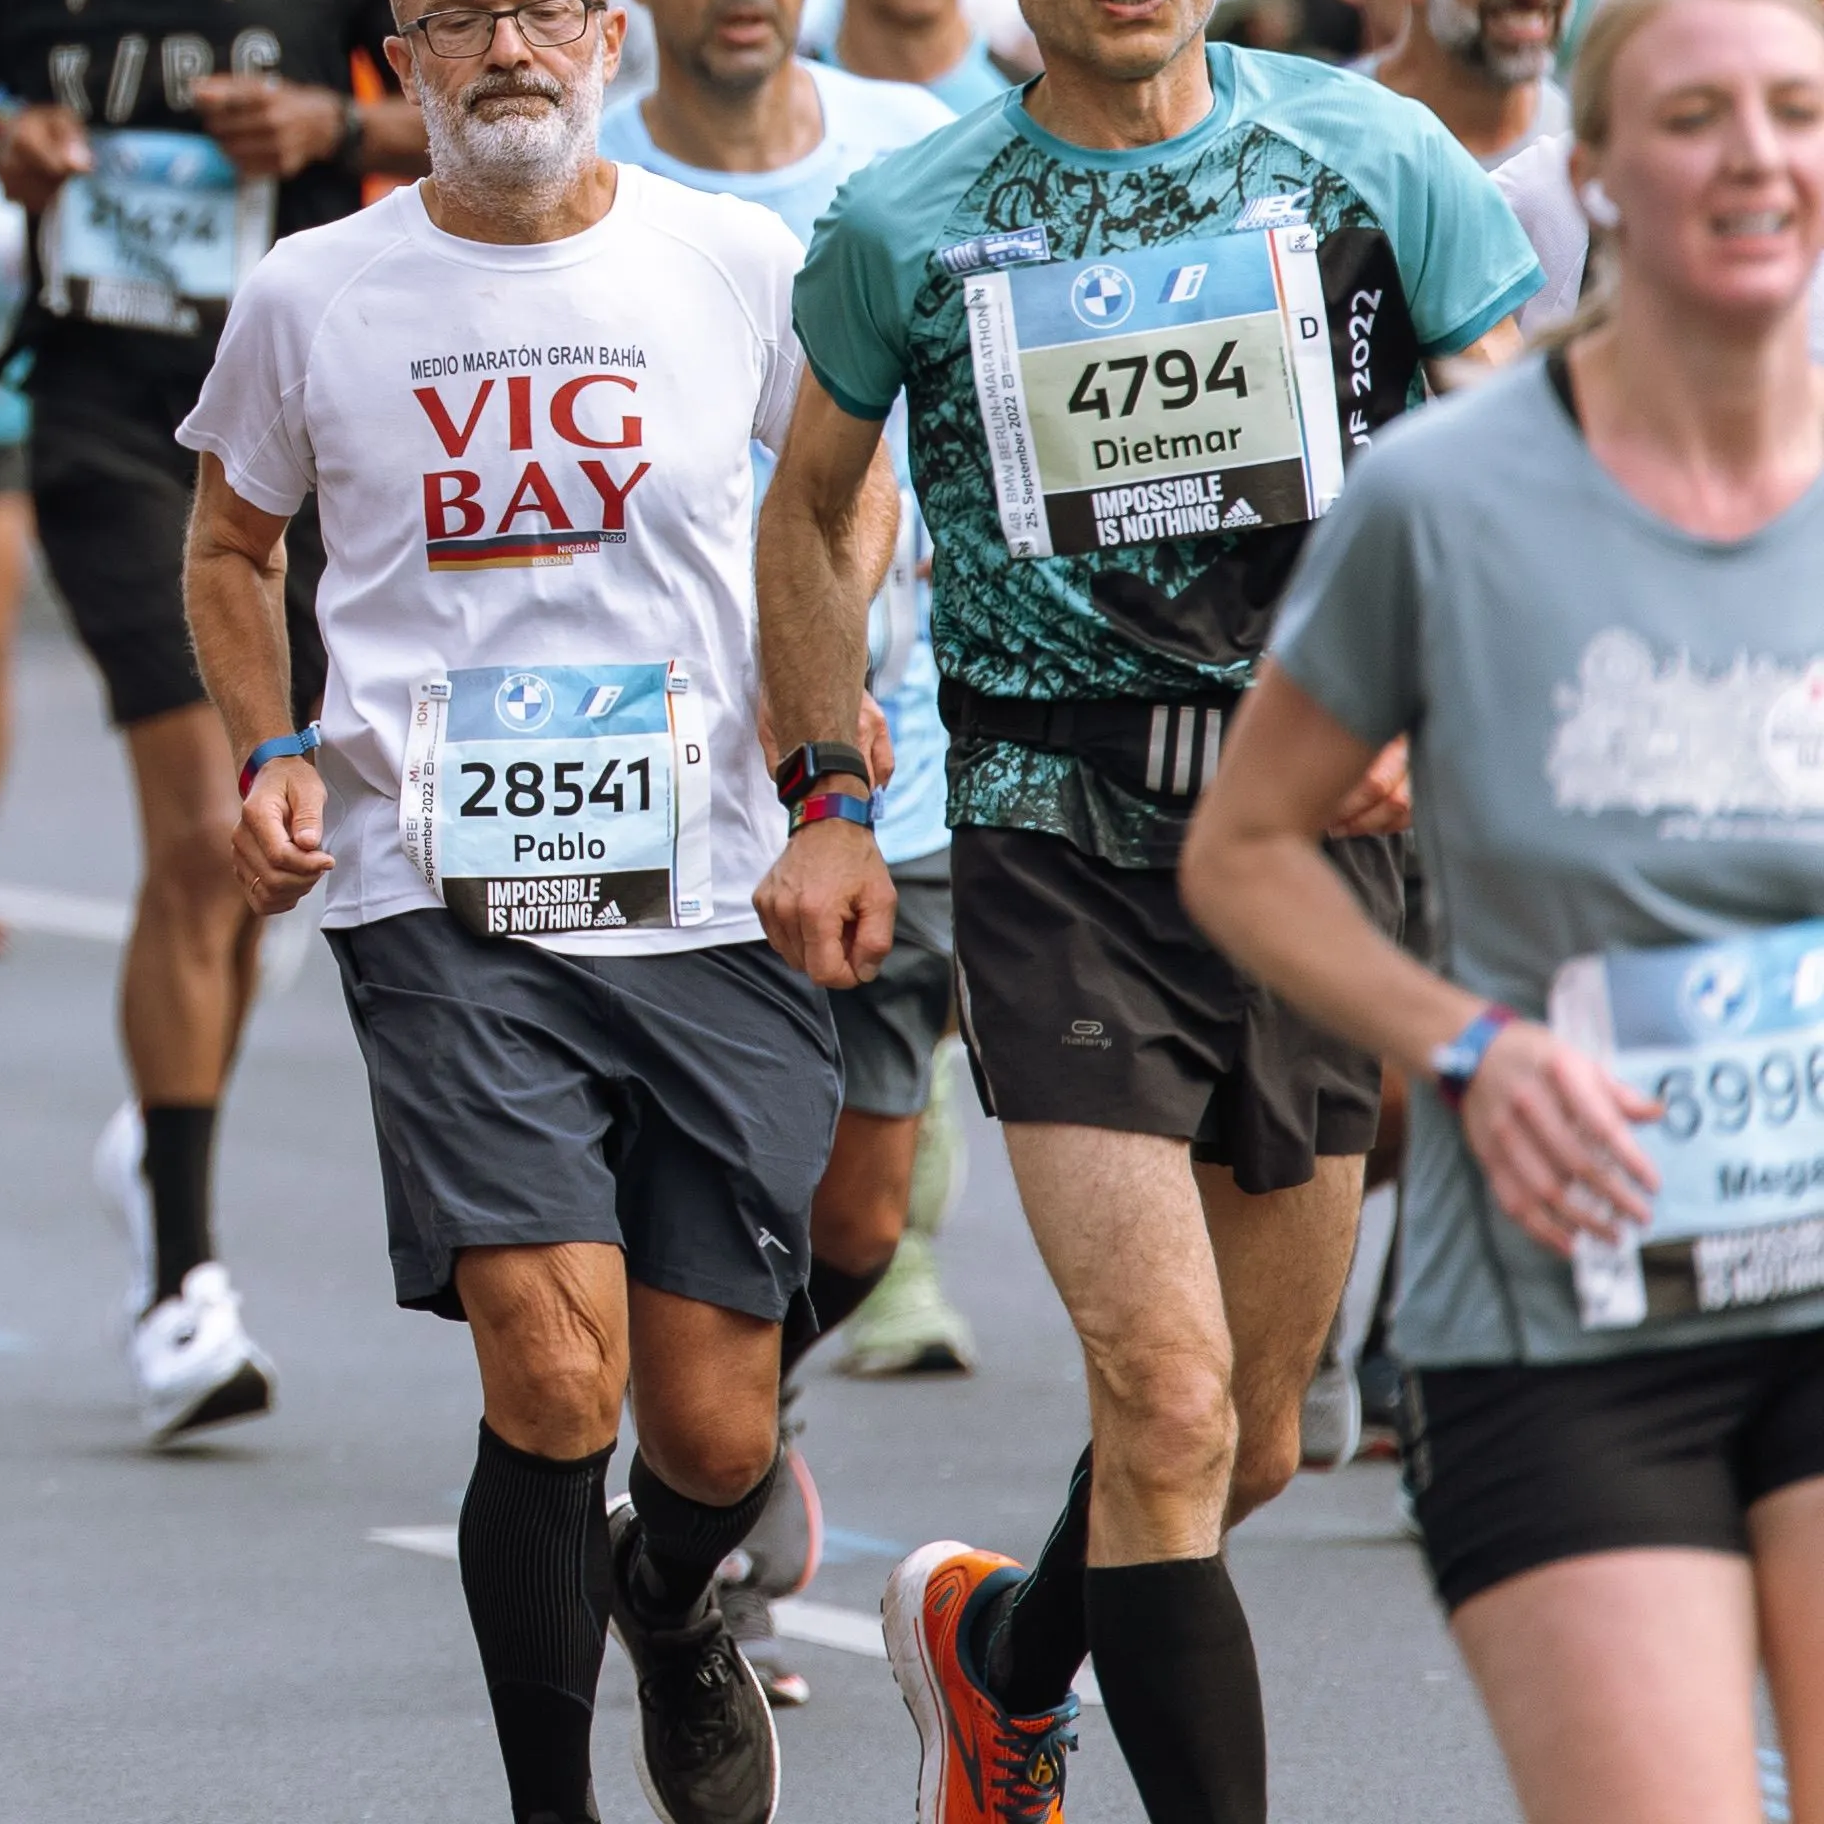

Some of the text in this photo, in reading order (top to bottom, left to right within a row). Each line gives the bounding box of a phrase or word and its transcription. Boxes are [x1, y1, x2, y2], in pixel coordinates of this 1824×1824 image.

[1300, 316, 1319, 340] D
[1349, 289, 1383, 397] 2022
[411, 344, 646, 380] MEDIO MARATÓN GRAN BAHÍA
[1068, 340, 1248, 421] 4794
[412, 374, 642, 458] VIG
[1003, 395, 1022, 430] 2022
[1093, 425, 1243, 471] Dietmar
[1002, 464, 1018, 504] BMW
[1015, 432, 1036, 505] September
[423, 460, 652, 541] BAY
[1091, 474, 1224, 519] IMPOSSIBLE
[1025, 508, 1039, 529] 25.
[1096, 504, 1220, 546] IS NOTHING
[1221, 514, 1262, 529] adidas
[558, 542, 599, 554] NIGRÁN
[599, 533, 625, 543] VIGO
[685, 744, 701, 764] D
[460, 757, 651, 817] 28541
[420, 781, 436, 885] September 2022
[514, 832, 607, 862] Pablo
[487, 877, 601, 907] IMPOSSIBLE
[488, 902, 593, 932] IS NOTHING
